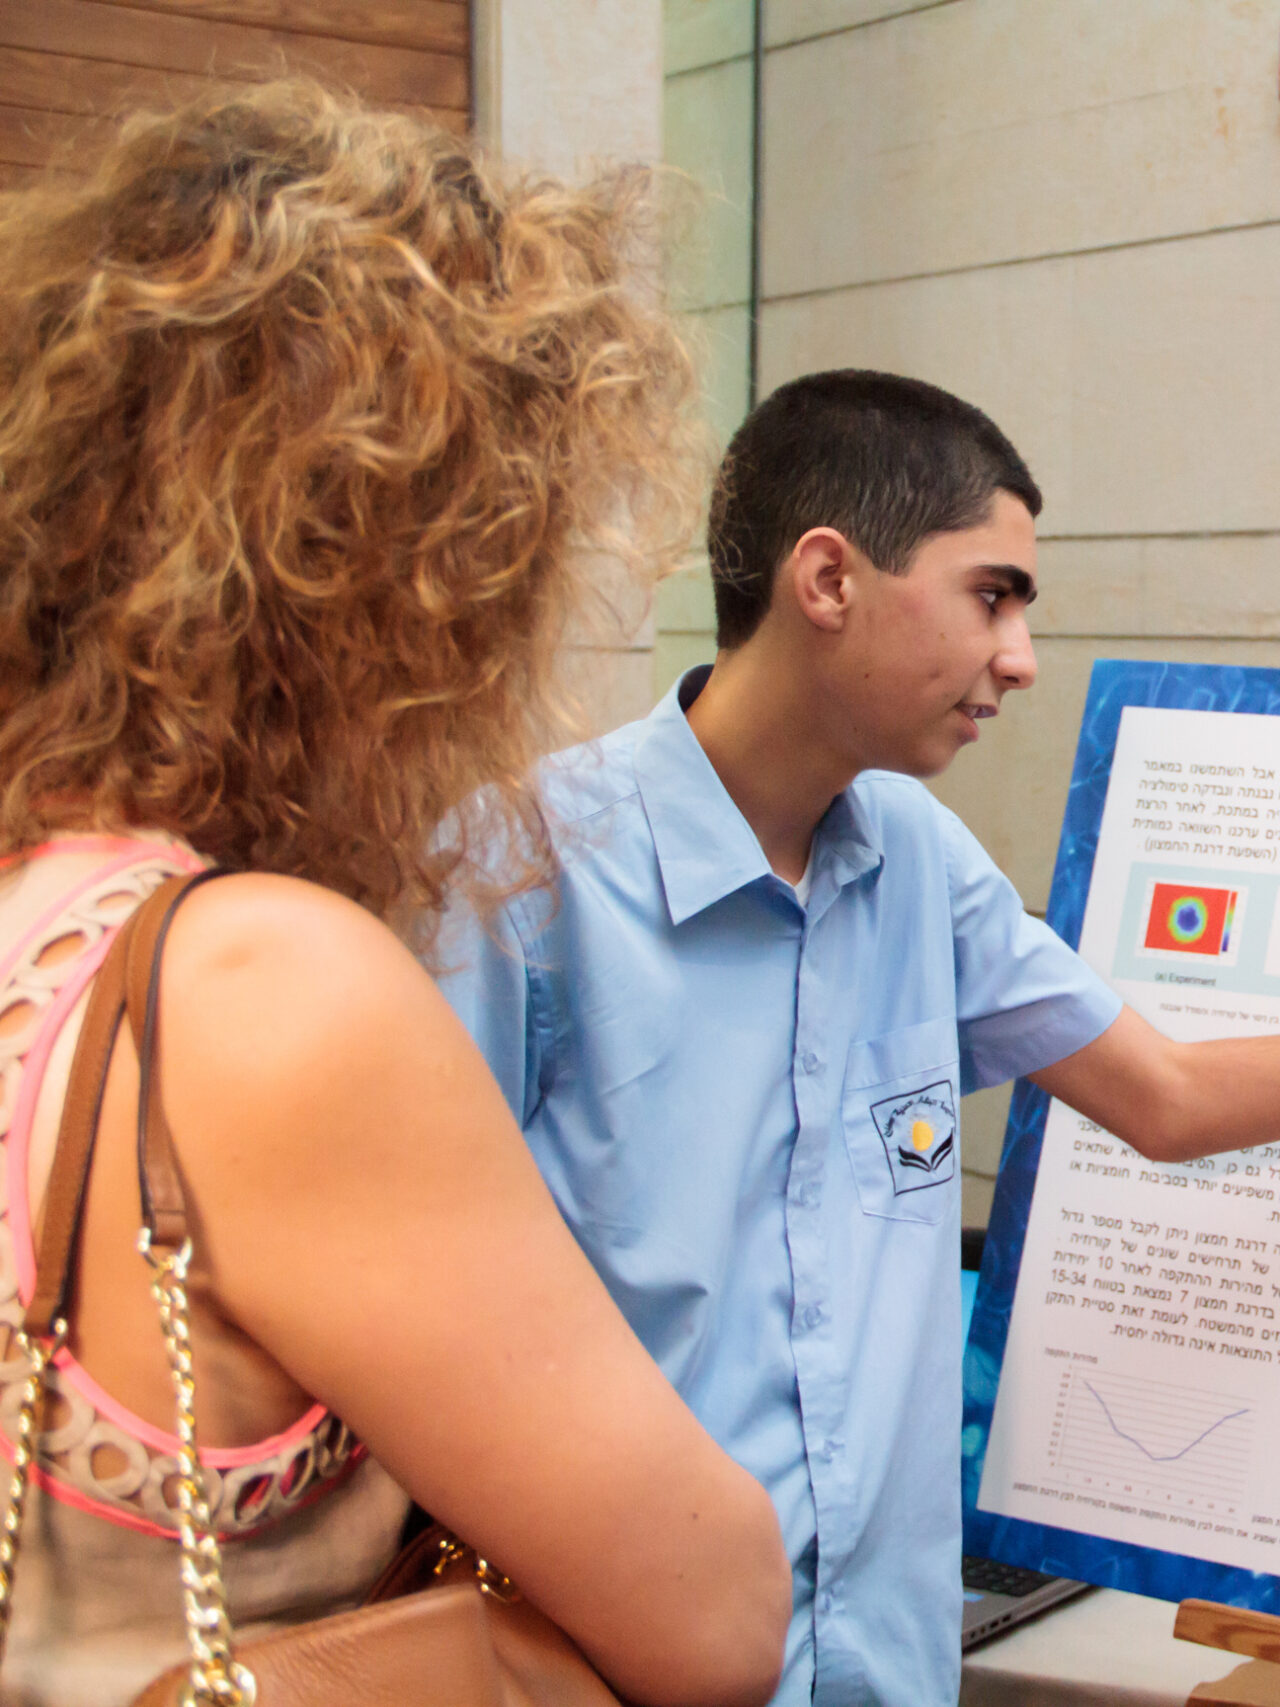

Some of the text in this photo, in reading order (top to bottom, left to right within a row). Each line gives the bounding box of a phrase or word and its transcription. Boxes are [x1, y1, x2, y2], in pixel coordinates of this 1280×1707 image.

[1143, 759, 1183, 773] במאמר
[1189, 763, 1245, 777] השתמשנו
[1251, 766, 1275, 780] אבל
[1138, 778, 1189, 793] סימולציה
[1192, 783, 1233, 797] ונבדקה
[1237, 786, 1274, 800] נבנתה
[1135, 798, 1168, 810] הרצת
[1175, 800, 1206, 814] לאחר
[1132, 817, 1173, 831] כמותית
[1178, 821, 1222, 835] השוואה
[1227, 826, 1259, 839] ערכנו
[1192, 842, 1224, 855] דרגת
[1226, 845, 1277, 862] (השפעת
[1169, 973, 1216, 987] Experiment
[1069, 1160, 1082, 1171] או
[1085, 1162, 1130, 1179] חומציות
[1138, 1169, 1189, 1188] בסביבות
[1192, 1177, 1218, 1192] יותר
[1221, 1182, 1275, 1201] משפיעים
[1060, 1207, 1084, 1224] גדול
[1091, 1214, 1123, 1230] מספר
[1129, 1218, 1160, 1237] לקבל
[1165, 1227, 1189, 1241] ניתן
[1069, 1232, 1112, 1251] קורוזיה
[1119, 1237, 1138, 1254] של
[1194, 1231, 1229, 1247] חמצון
[1234, 1237, 1268, 1253] דרגת
[1052, 1250, 1089, 1265] יחידות
[1146, 1244, 1179, 1260] שונים
[1098, 1255, 1114, 1271] 10
[1119, 1261, 1152, 1276] לאחר
[1187, 1251, 1242, 1271] תרחישים
[1251, 1258, 1270, 1275] של
[1051, 1268, 1087, 1287] 15-34
[1158, 1267, 1212, 1288] ההתקפה
[1092, 1277, 1126, 1295] בטווח
[1132, 1284, 1173, 1302] נמצאת
[1217, 1277, 1264, 1296] מהירות
[1044, 1291, 1076, 1306] התקן
[1179, 1289, 1189, 1303] 7
[1193, 1295, 1228, 1311] חמצון
[1080, 1296, 1116, 1313] סטיית
[1120, 1303, 1145, 1318] זאת
[1233, 1302, 1275, 1320] בדרגת
[1149, 1308, 1189, 1326] לעומת
[1151, 1328, 1185, 1347] גדולה
[1188, 1336, 1216, 1353] אינה
[1218, 1342, 1273, 1363] התוצאות
